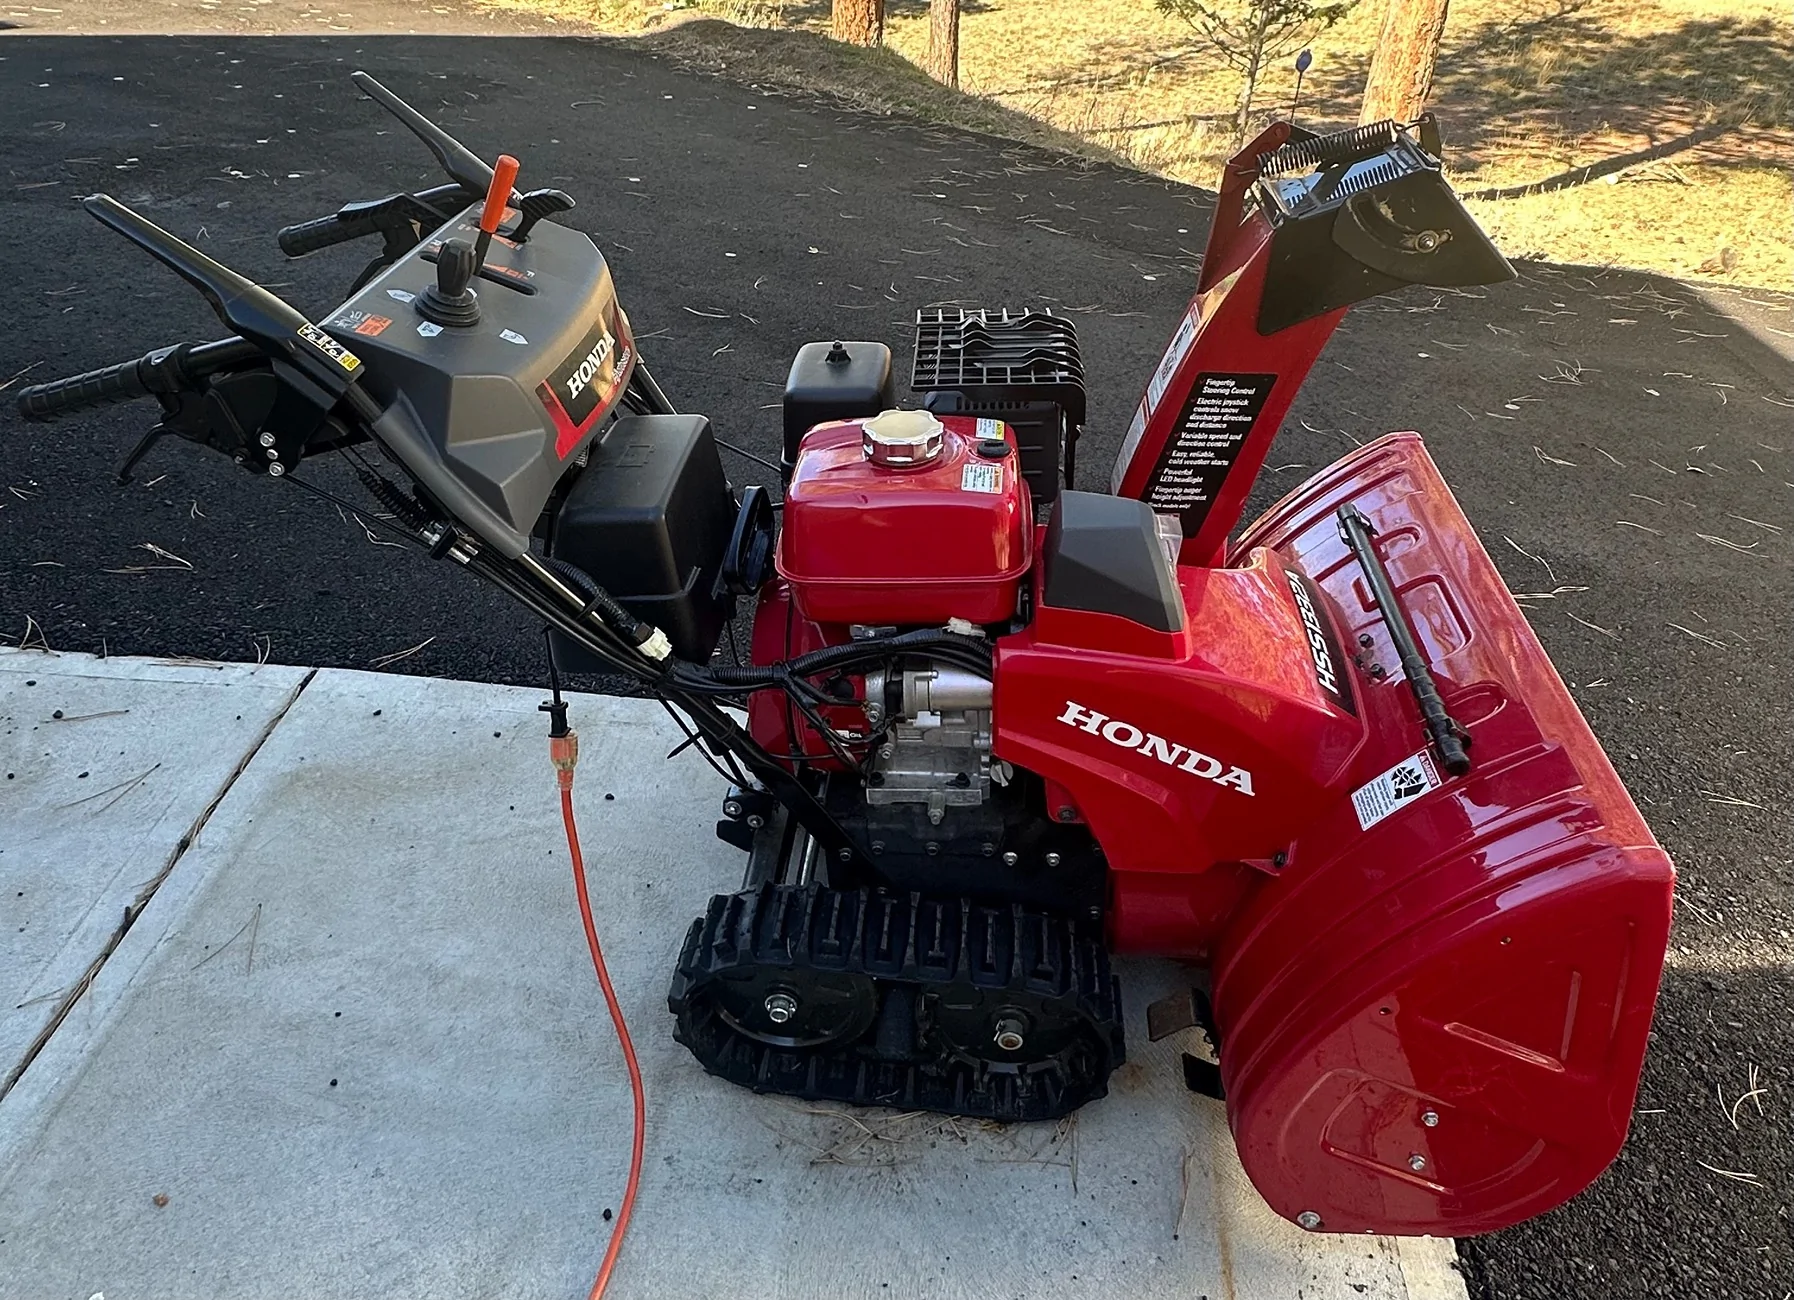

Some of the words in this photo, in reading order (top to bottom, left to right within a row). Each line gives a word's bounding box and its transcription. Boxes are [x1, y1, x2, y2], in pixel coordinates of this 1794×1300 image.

[566, 329, 615, 399] HONDA
[1206, 378, 1236, 387] Fingertip
[1202, 386, 1230, 395] Steering
[1231, 387, 1256, 395] Control
[1197, 397, 1222, 405] Electric
[1222, 398, 1249, 406] joystick
[1189, 413, 1222, 422] discharge
[1222, 414, 1252, 422] direction
[1199, 421, 1227, 429] distance
[1181, 431, 1208, 439] Variable
[1208, 432, 1229, 441] speed
[1177, 439, 1206, 447] direction
[1163, 467, 1194, 476] Powerful
[1173, 476, 1204, 484] headlight
[1154, 485, 1183, 494] Fingertip
[1151, 492, 1172, 502] height
[1284, 569, 1339, 695] HSS1332A
[1056, 700, 1255, 797] HONDA
